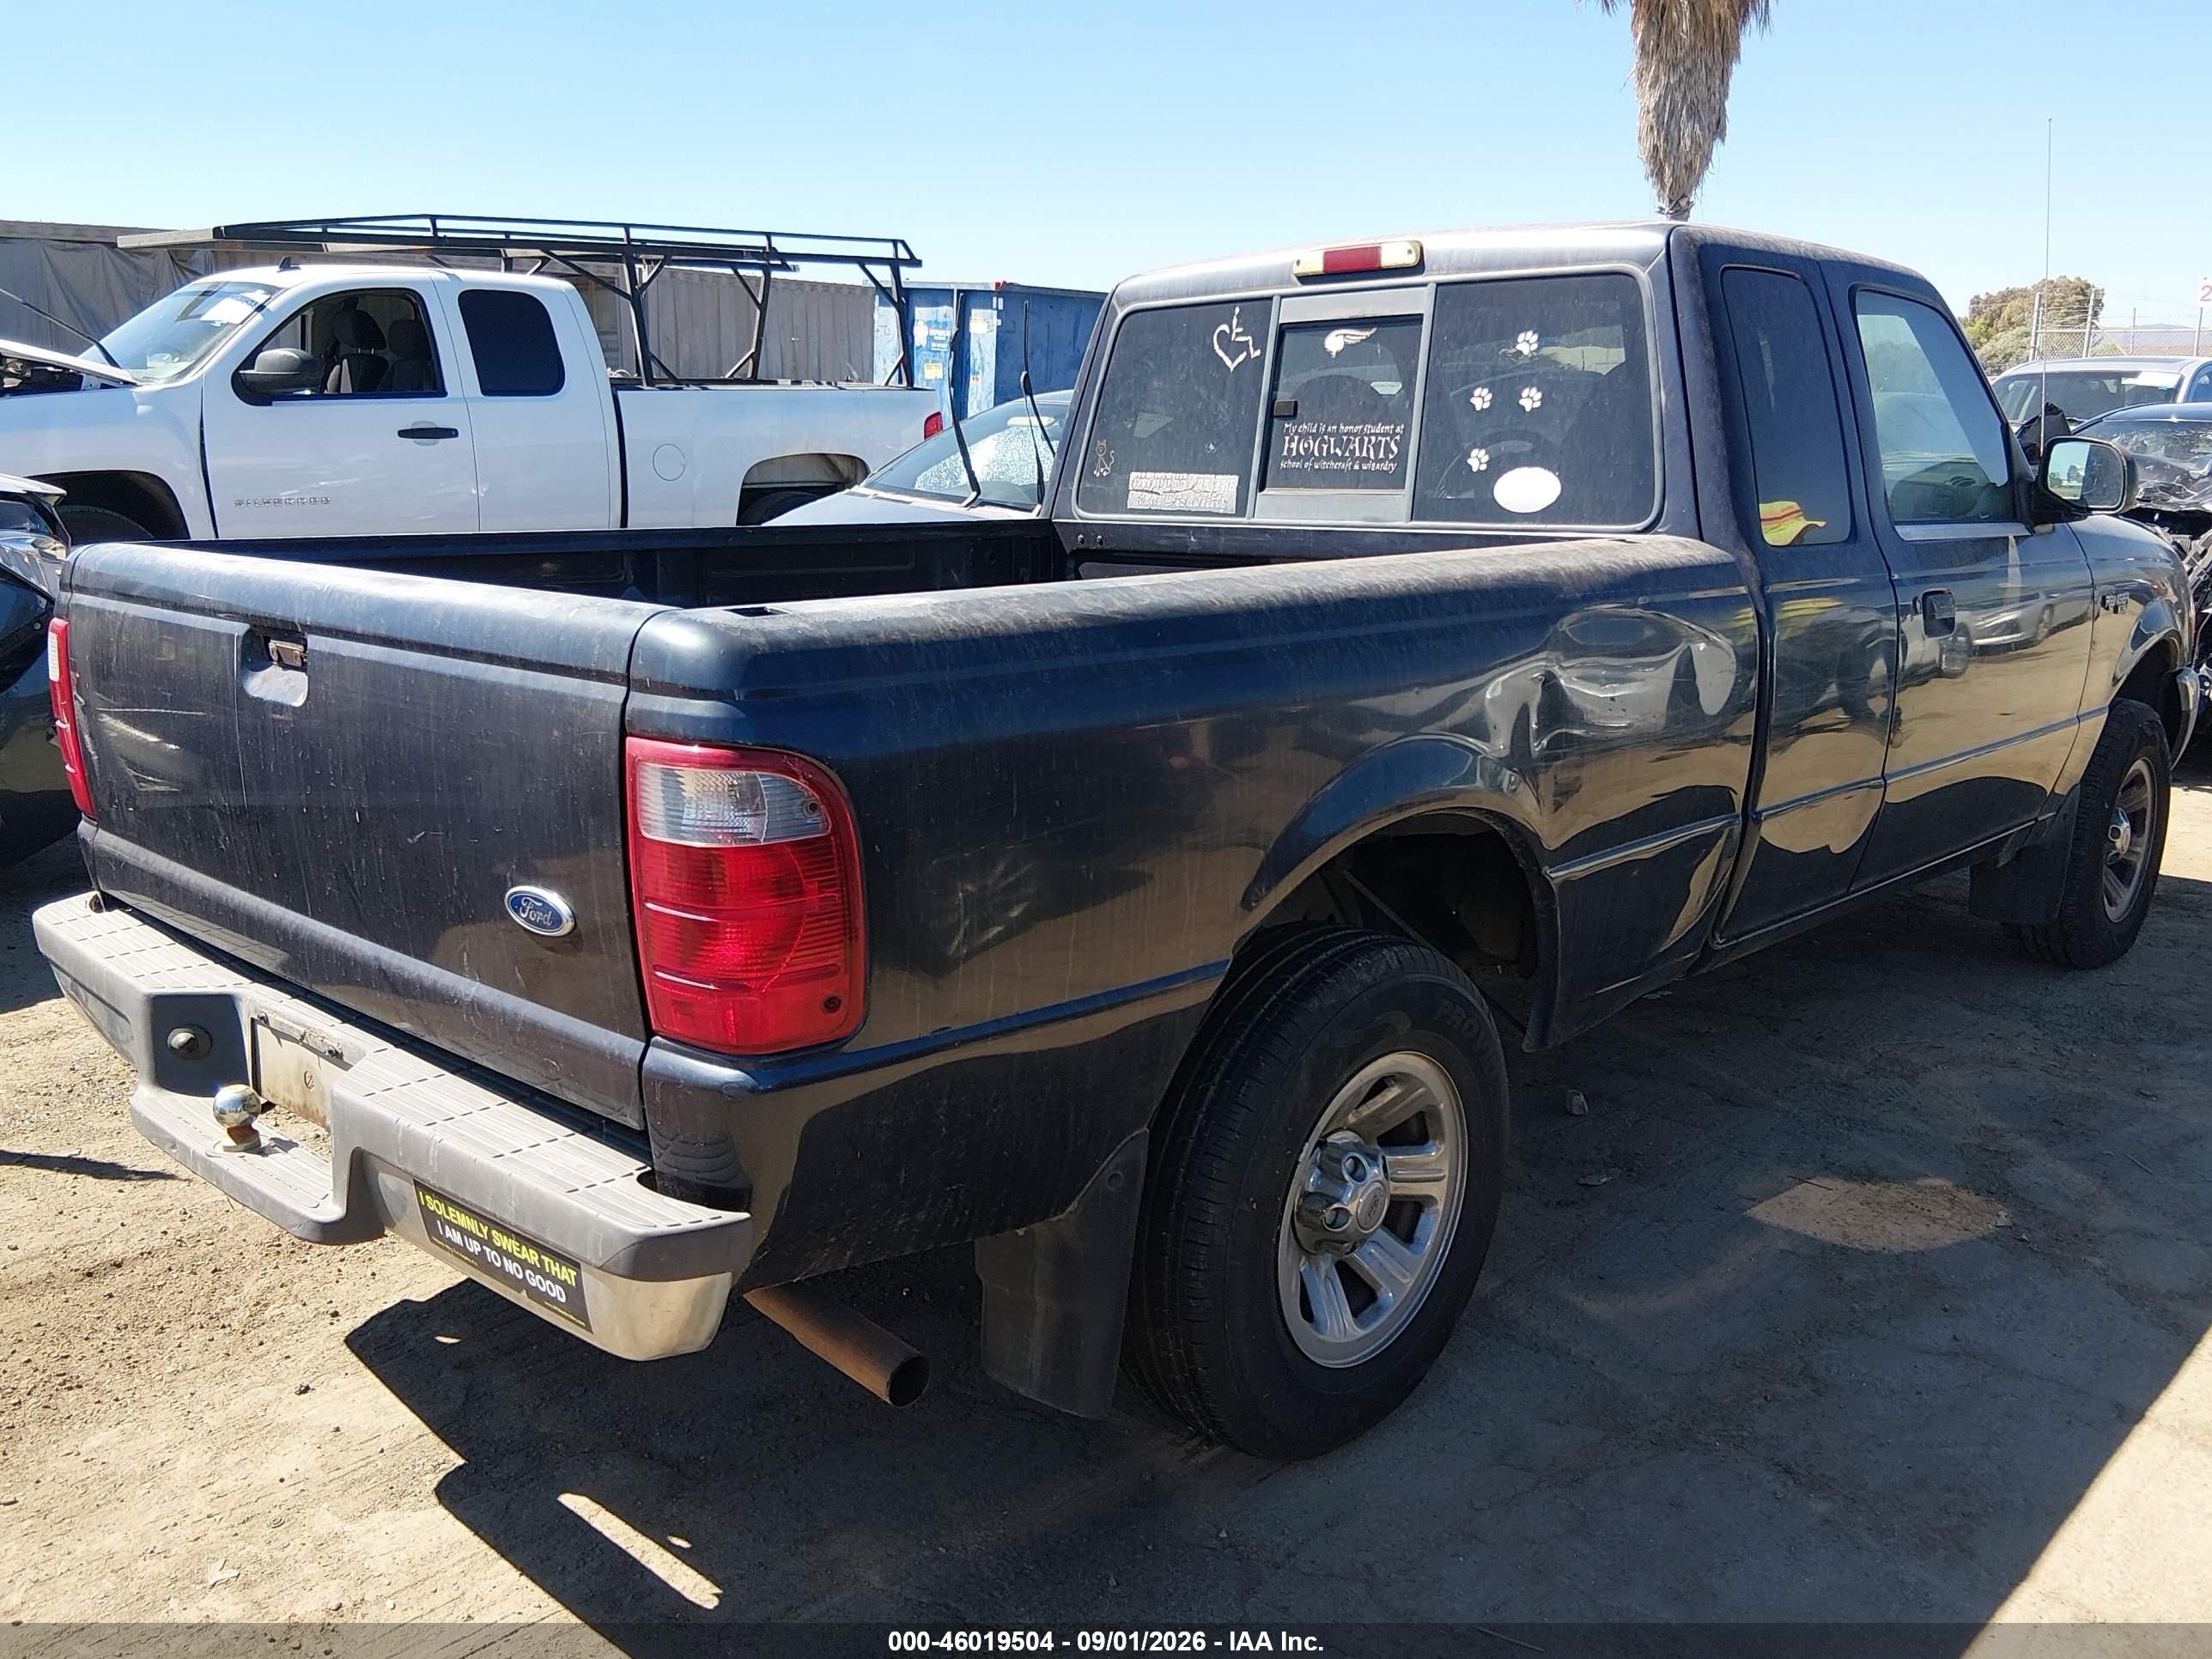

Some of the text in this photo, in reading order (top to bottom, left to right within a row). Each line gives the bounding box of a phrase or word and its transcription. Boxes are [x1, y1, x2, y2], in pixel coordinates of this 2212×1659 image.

[1283, 422, 1405, 435] My child is an honor student at
[1281, 434, 1401, 460] HOGWARTS
[1279, 457, 1398, 474] school of witchcraft & wizardry
[519, 896, 553, 926] Ford
[418, 1190, 425, 1206] I
[424, 1194, 489, 1240] SOLEMNLY
[491, 1229, 541, 1268] SWEAR
[541, 1254, 577, 1287] THAT
[436, 1219, 443, 1236] I
[445, 1224, 463, 1246] AM
[464, 1235, 482, 1255] UP
[483, 1245, 501, 1268] TO
[502, 1255, 524, 1280] NO
[525, 1269, 567, 1304] GOOD
